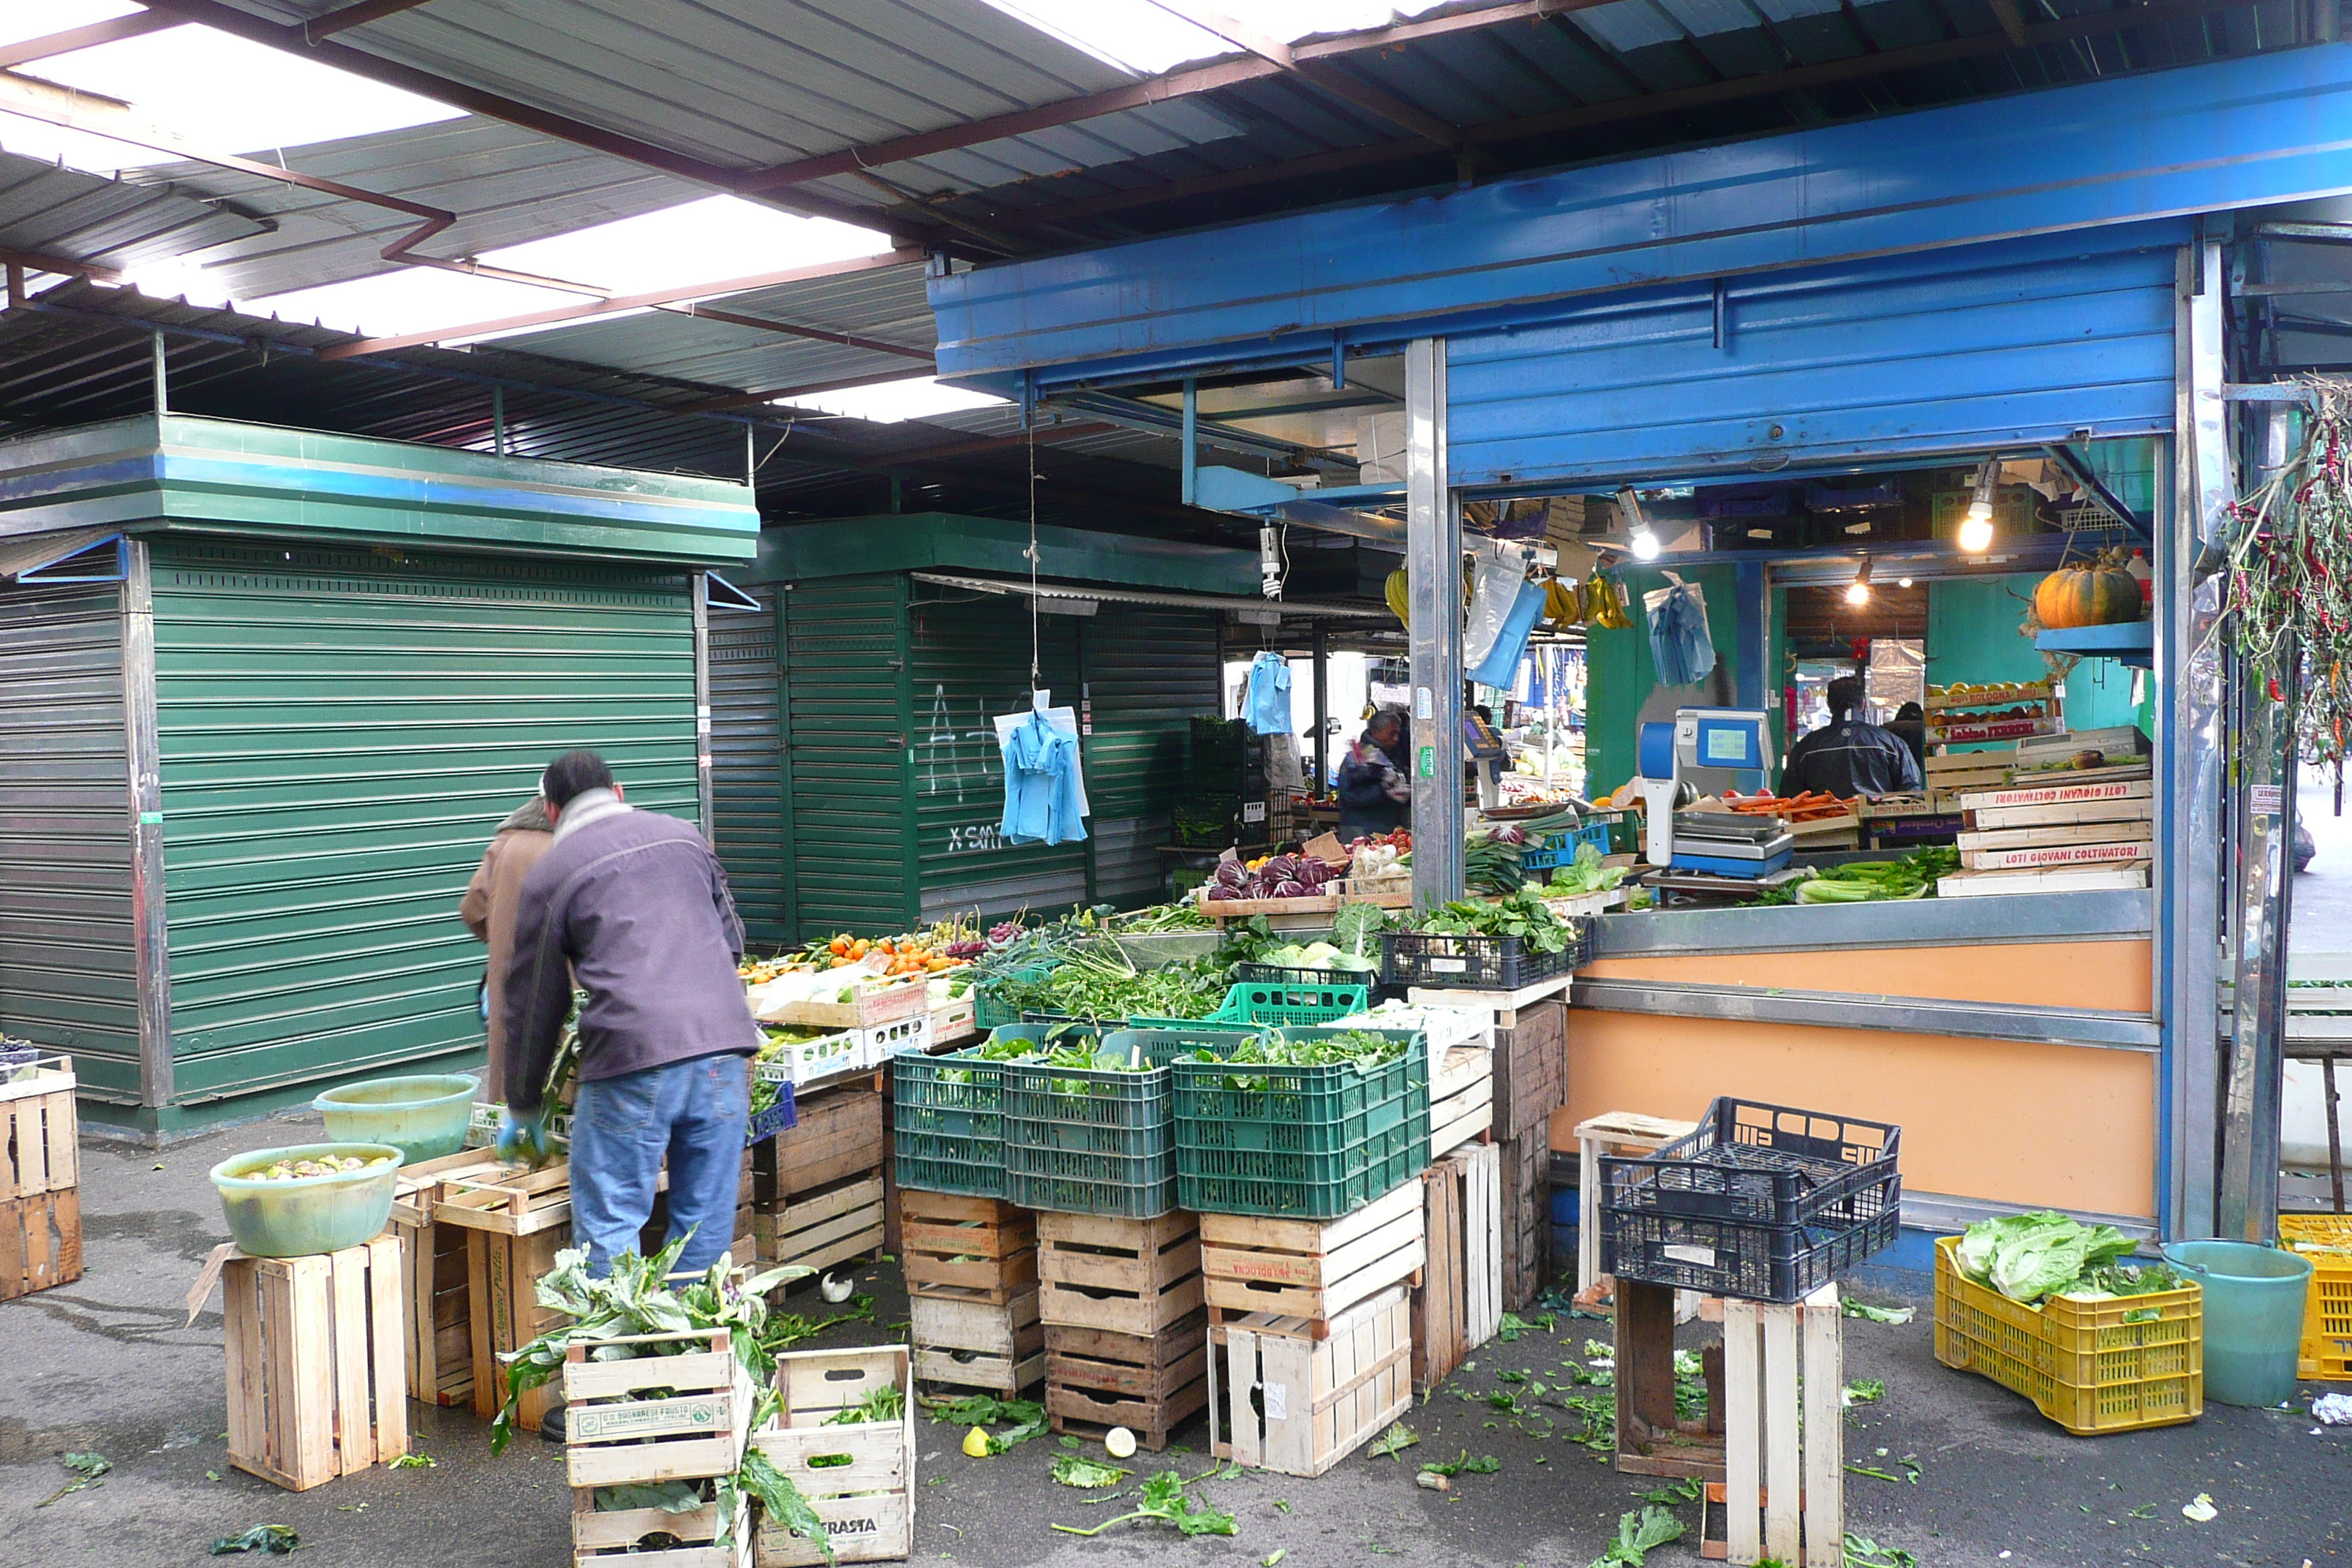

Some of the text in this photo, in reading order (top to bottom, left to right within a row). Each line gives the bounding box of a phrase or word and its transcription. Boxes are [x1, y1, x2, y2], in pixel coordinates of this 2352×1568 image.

[1970, 690, 2010, 702] BOLOGNA
[1995, 785, 2127, 804] LOTI GIOVANI COLTIVATORI
[2006, 846, 2138, 864] LOTI GIOVANI COLTIVATORI
[1233, 1264, 1273, 1277] BOLOGNA
[617, 1409, 658, 1420] BAGNARESI
[660, 1405, 689, 1416] FAUSTO
